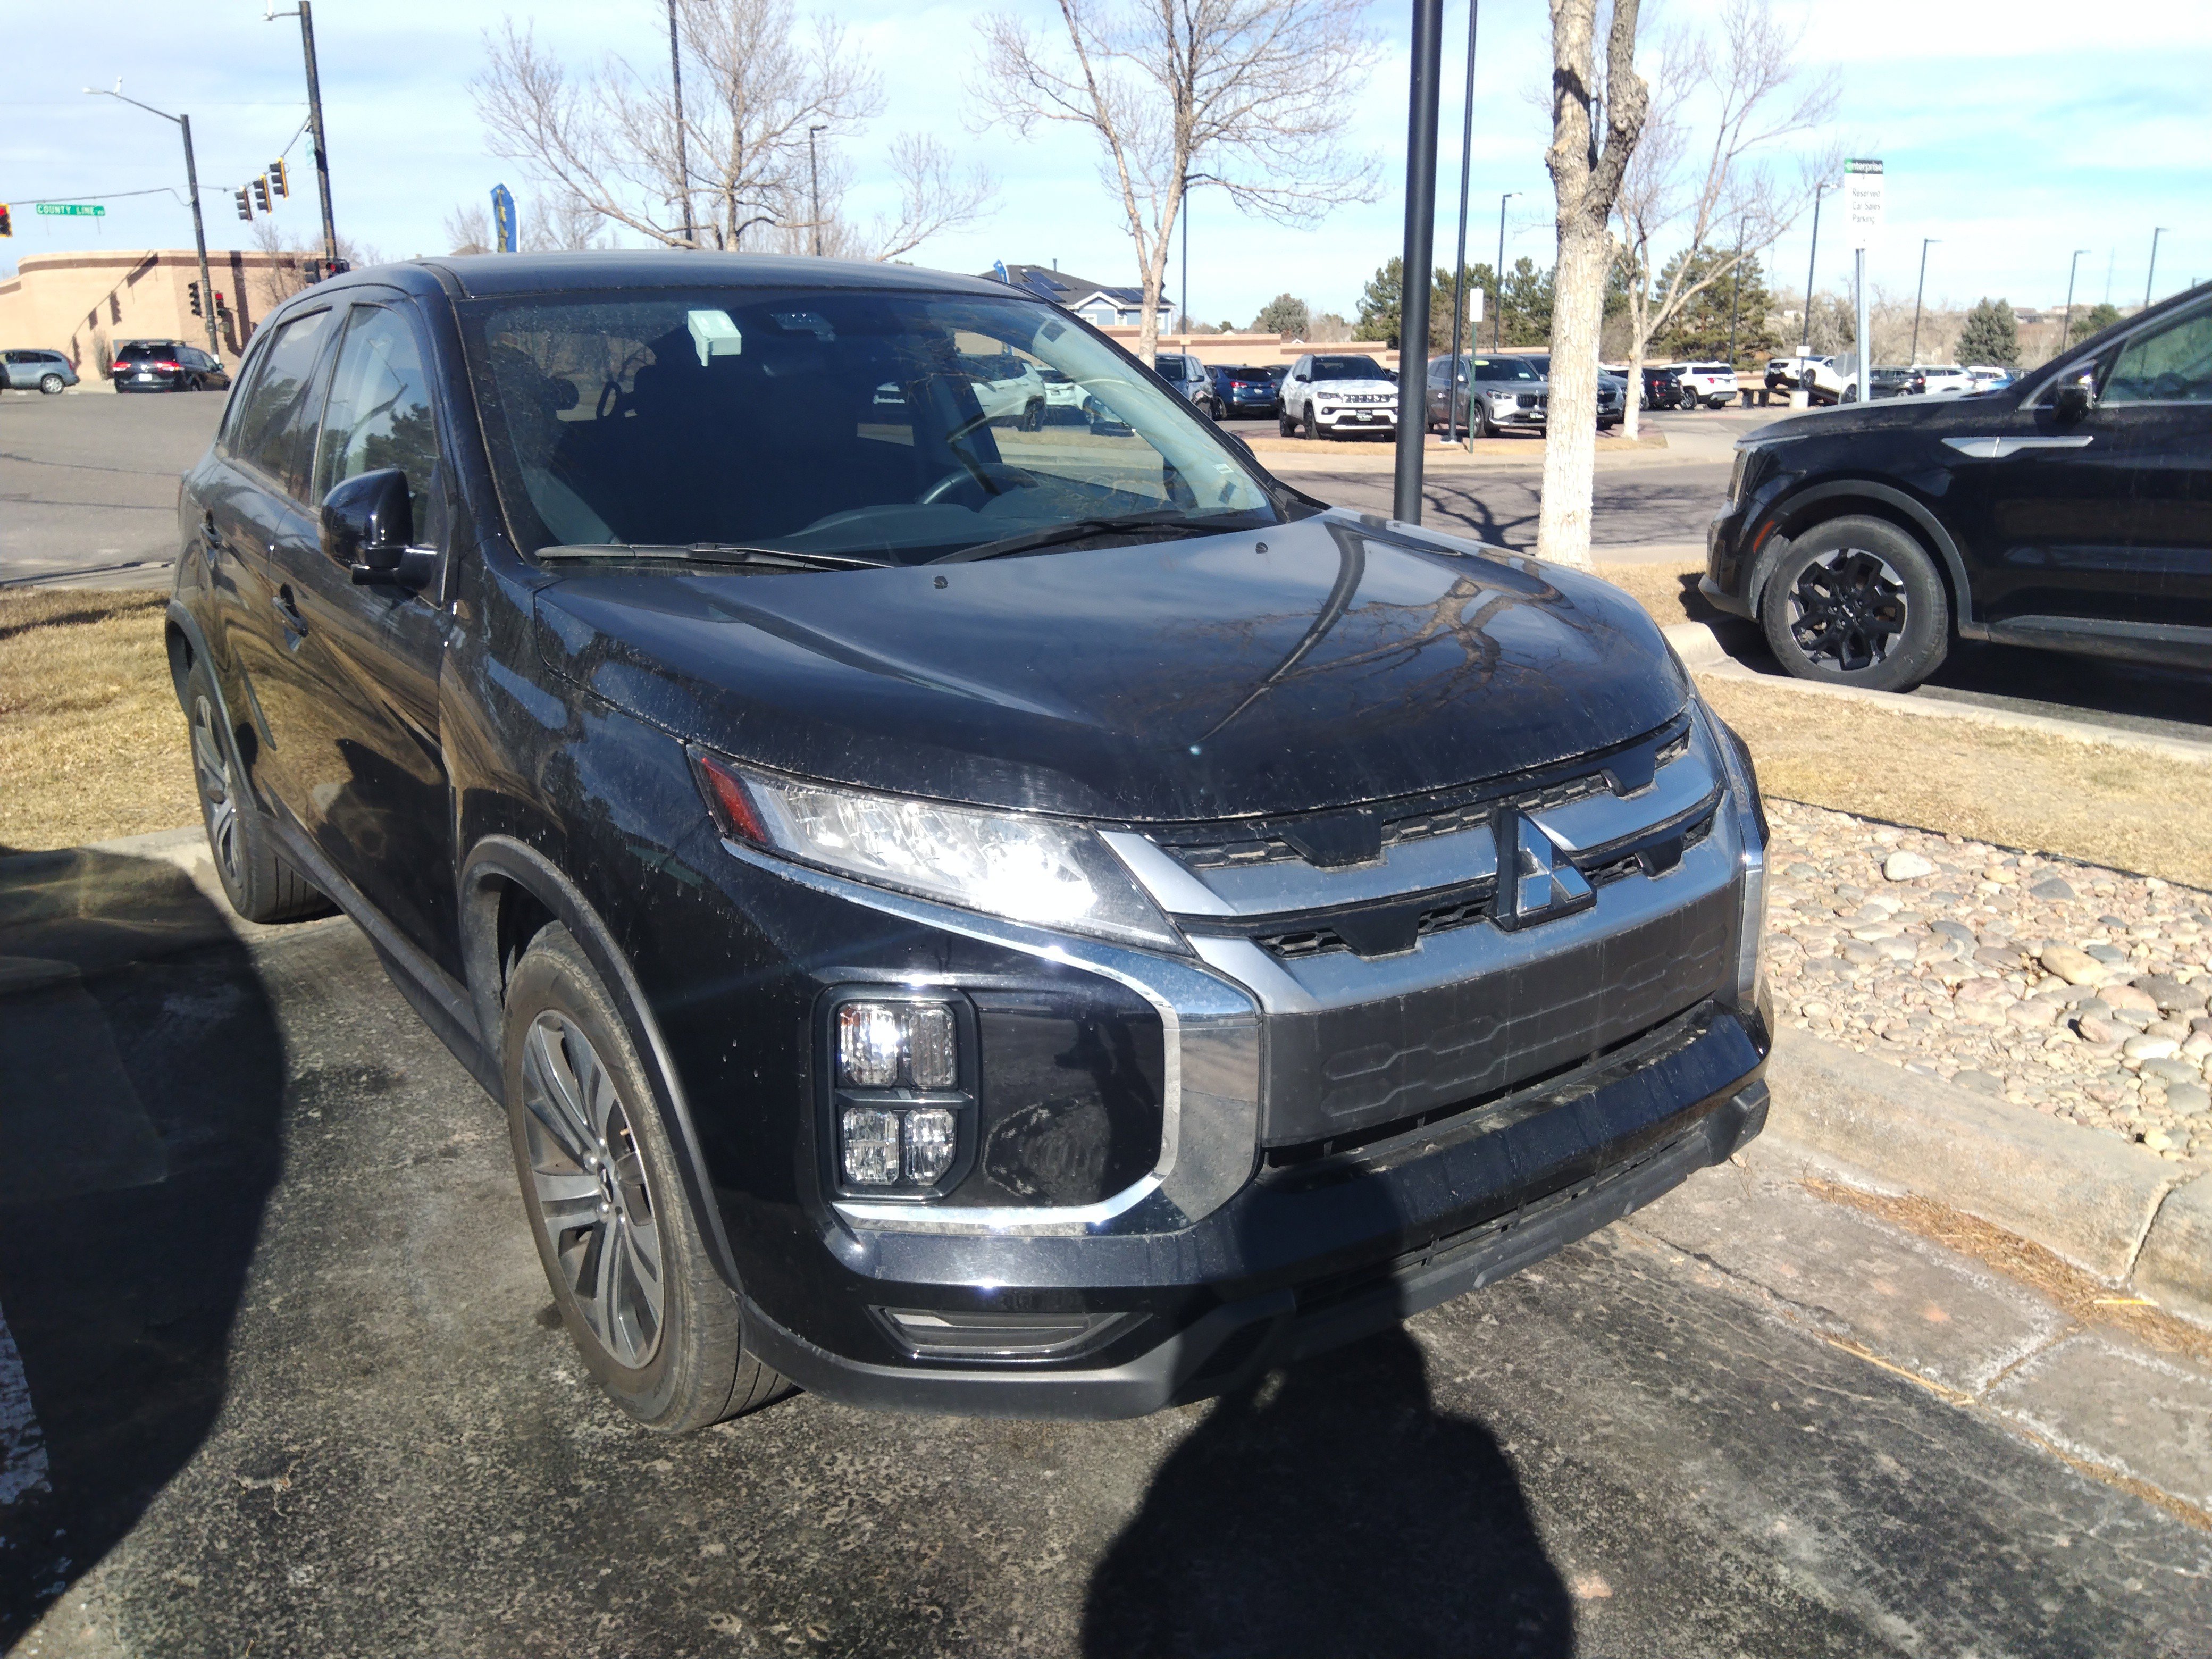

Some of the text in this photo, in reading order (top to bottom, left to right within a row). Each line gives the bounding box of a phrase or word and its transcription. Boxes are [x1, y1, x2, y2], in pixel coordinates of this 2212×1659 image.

[1846, 161, 1883, 173] enterprise
[1853, 188, 1880, 197] Reserved
[38, 205, 71, 214] COUNTY
[76, 206, 95, 215] LINE
[1853, 201, 1881, 210] Car Sales
[1853, 213, 1875, 225] Parking
